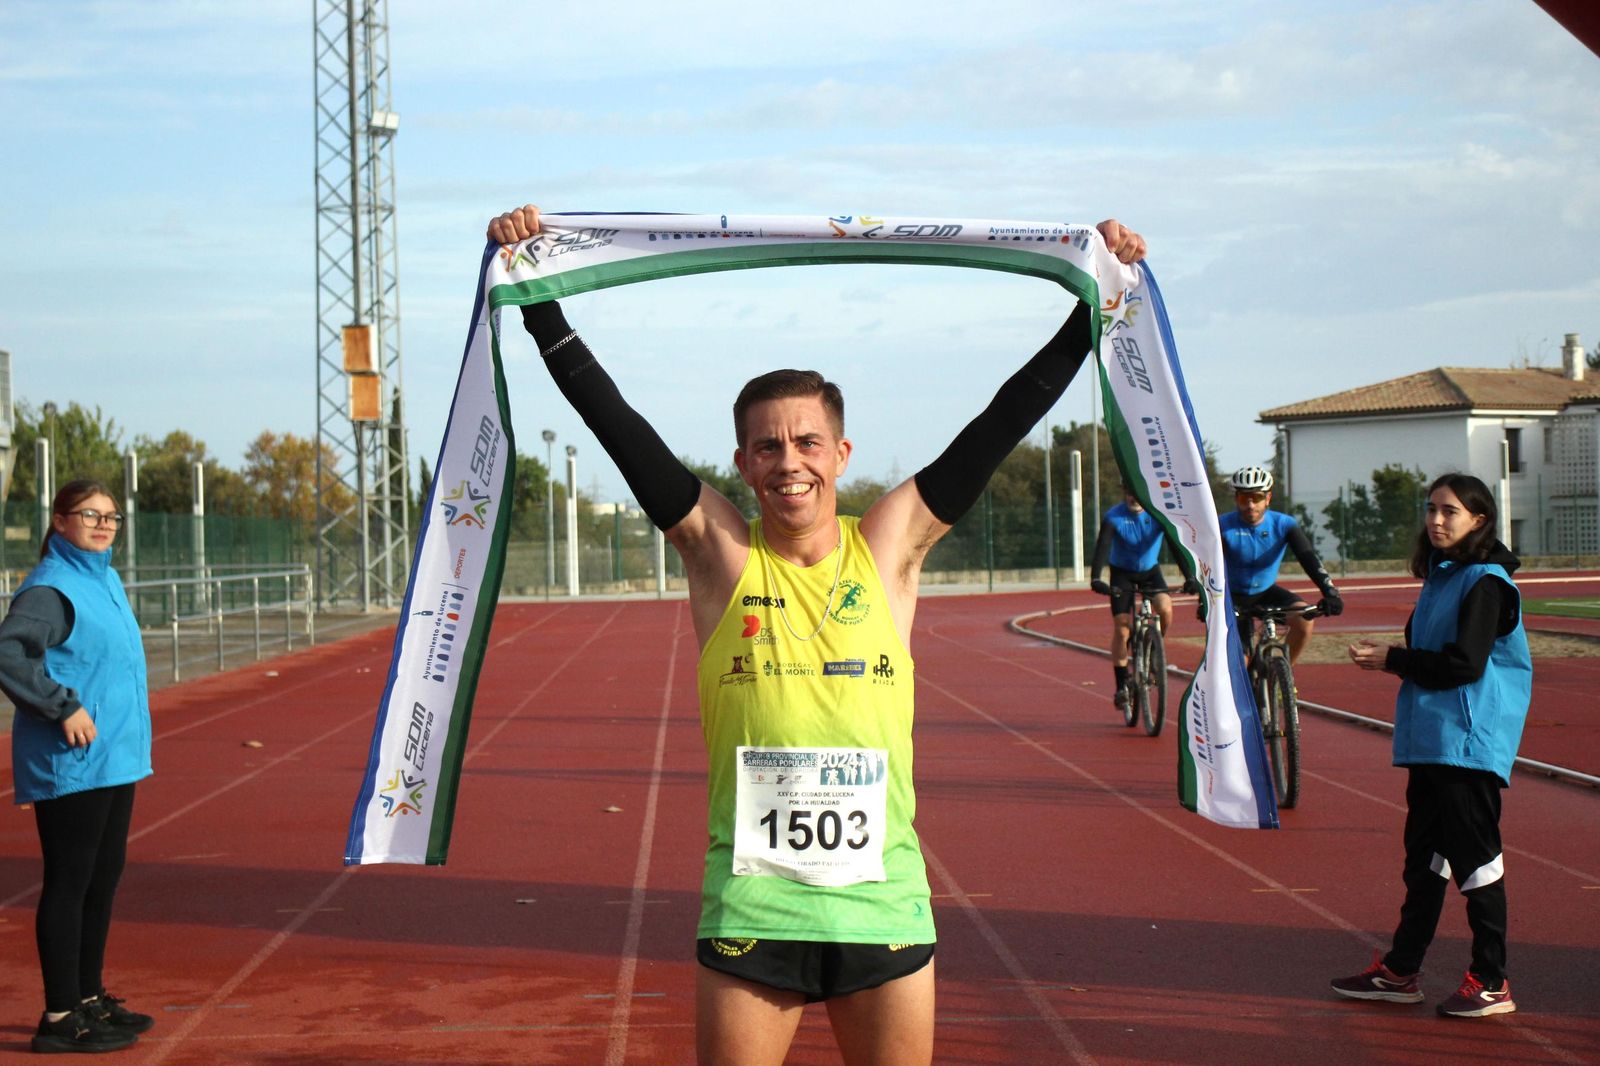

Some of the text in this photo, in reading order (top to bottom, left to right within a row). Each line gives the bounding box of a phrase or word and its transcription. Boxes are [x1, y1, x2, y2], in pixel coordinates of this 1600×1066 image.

[548, 239, 613, 257] Lucena
[890, 225, 963, 236] SDM
[989, 227, 1049, 236] Ayuntamiento
[1052, 227, 1063, 235] de
[1111, 338, 1136, 388] Lucena
[1120, 337, 1153, 394] SDM
[470, 415, 495, 478] SDM
[481, 428, 501, 488] Lucena
[422, 590, 448, 680] Ayuntamiento de Lucena
[760, 627, 773, 638] DS
[403, 701, 427, 767] SDM
[414, 711, 434, 771] Lucena
[760, 809, 870, 851] 1503
